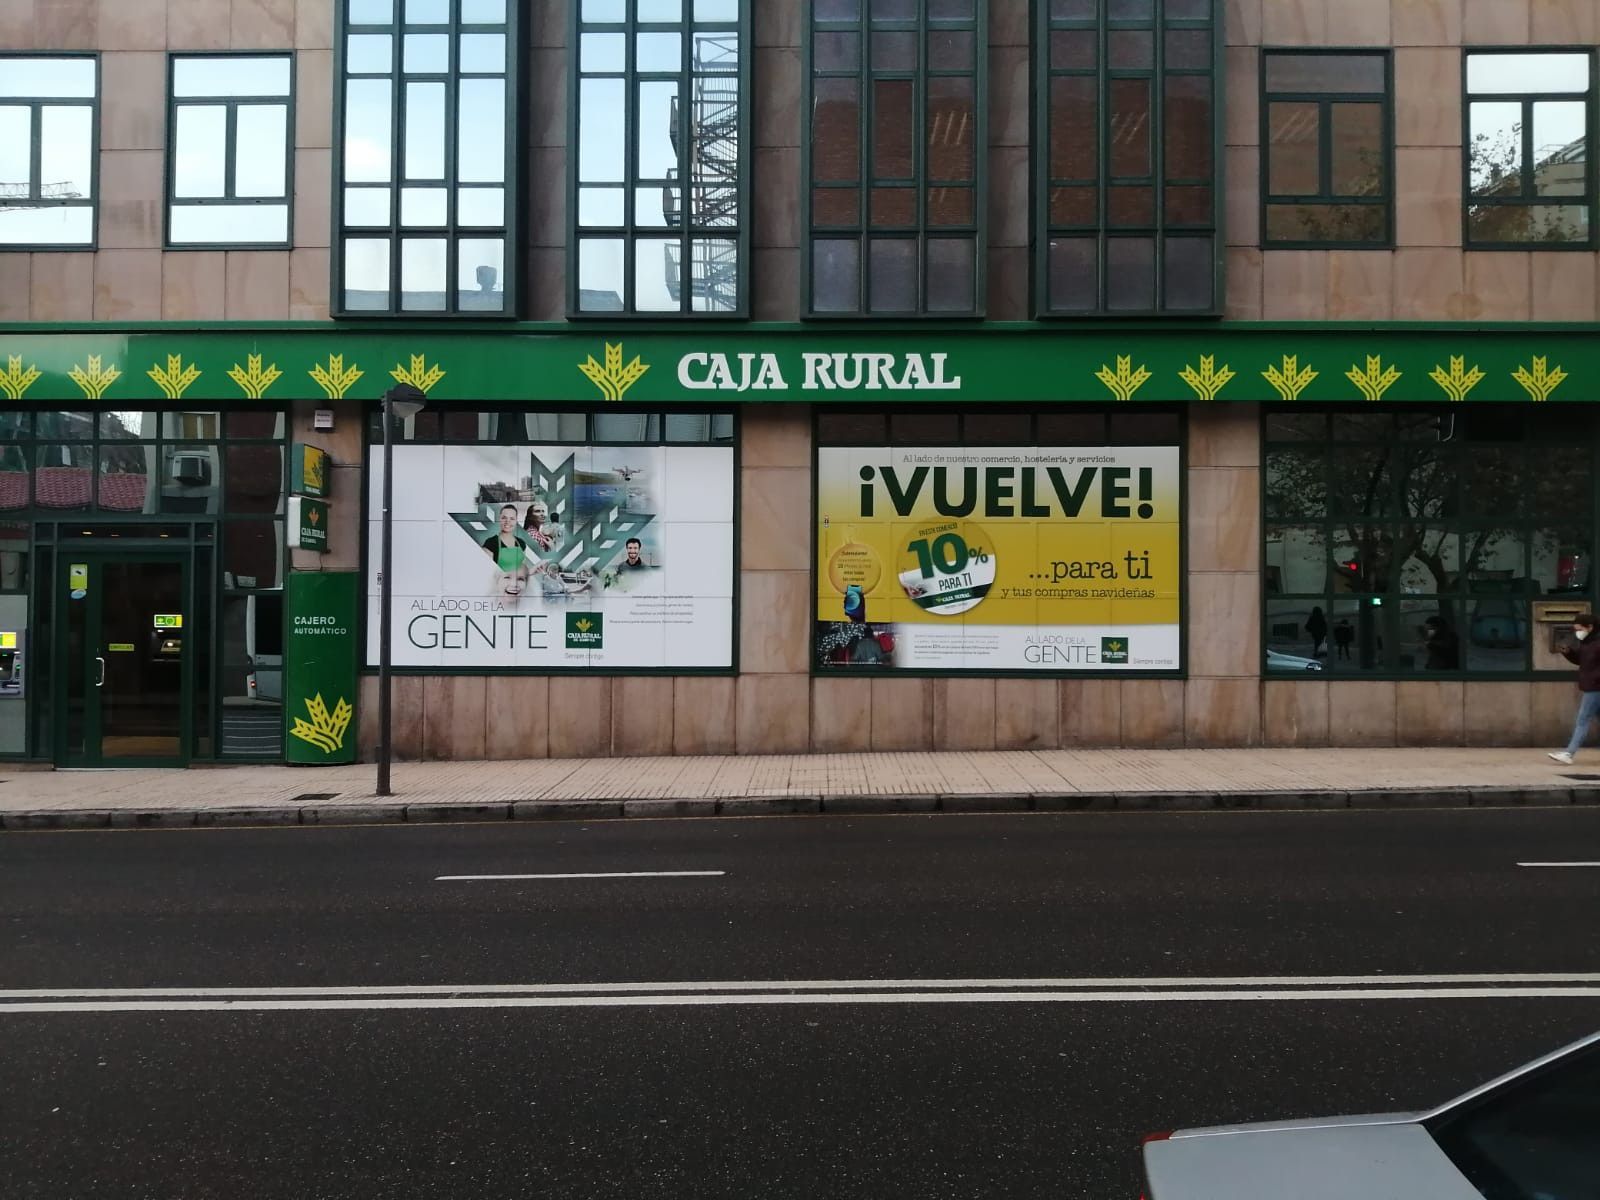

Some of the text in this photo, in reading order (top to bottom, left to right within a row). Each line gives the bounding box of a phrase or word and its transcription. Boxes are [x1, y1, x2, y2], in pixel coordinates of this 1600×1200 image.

[677, 352, 961, 392] CAJA RURAL
[914, 454, 932, 463] lado
[933, 454, 945, 463] de
[946, 455, 979, 463] nuestro
[981, 455, 1024, 464] comercio,
[1068, 456, 1076, 465] y
[1077, 455, 1116, 463] servicios
[859, 464, 1154, 520] ¡VUELVE!
[907, 532, 989, 580] 10%
[1123, 550, 1153, 579] ti
[938, 572, 973, 591] PARA TI
[1000, 586, 1156, 600] y tus compras navideñas
[411, 599, 505, 612] AL LADO DE LA
[294, 616, 336, 625] CAJERO
[407, 614, 548, 649] GENTE
[1025, 635, 1035, 644] AL
[1037, 635, 1064, 644] LADO
[1065, 637, 1075, 645] DE
[1024, 645, 1097, 664] GENTE
